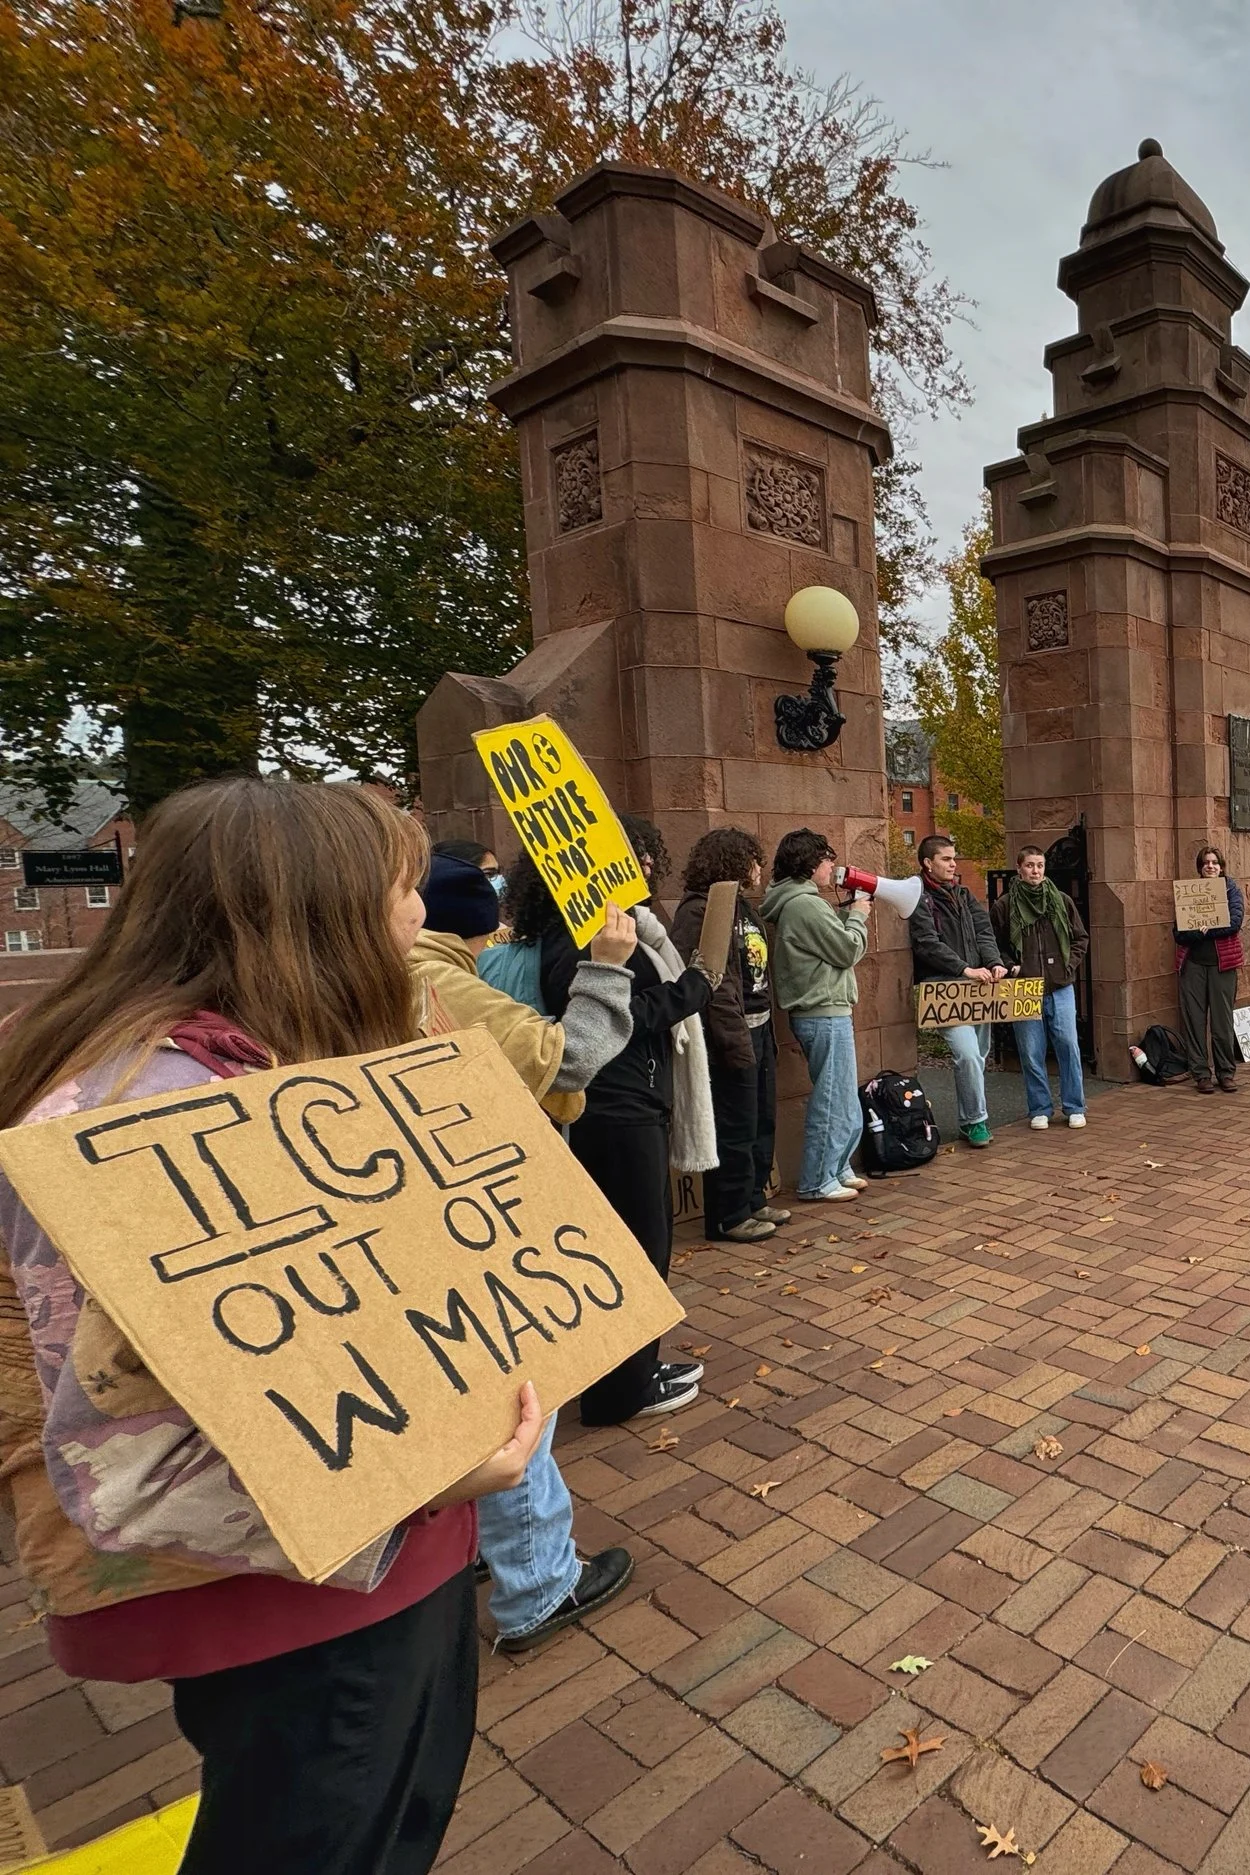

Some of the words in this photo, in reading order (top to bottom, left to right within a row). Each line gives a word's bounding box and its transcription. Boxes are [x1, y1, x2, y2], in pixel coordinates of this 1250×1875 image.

[490, 738, 547, 803] OUR
[513, 779, 599, 857] FUTURE
[35, 865, 61, 874] Mary
[89, 864, 110, 872] Hall
[541, 853, 563, 893] IS
[556, 836, 596, 882] NOT
[563, 855, 638, 932] NEGOTIABLE
[1181, 883, 1204, 896] ICE
[923, 981, 1000, 1001] PROTECT
[1013, 978, 1045, 998] FREE
[1013, 998, 1042, 1018] DOM
[920, 1000, 1009, 1026] ACADEMIC
[74, 1041, 529, 1284] ICE
[212, 1227, 403, 1356] OUT
[443, 1173, 525, 1252] OF
[263, 1340, 411, 1472] W
[405, 1223, 626, 1396] MASS
